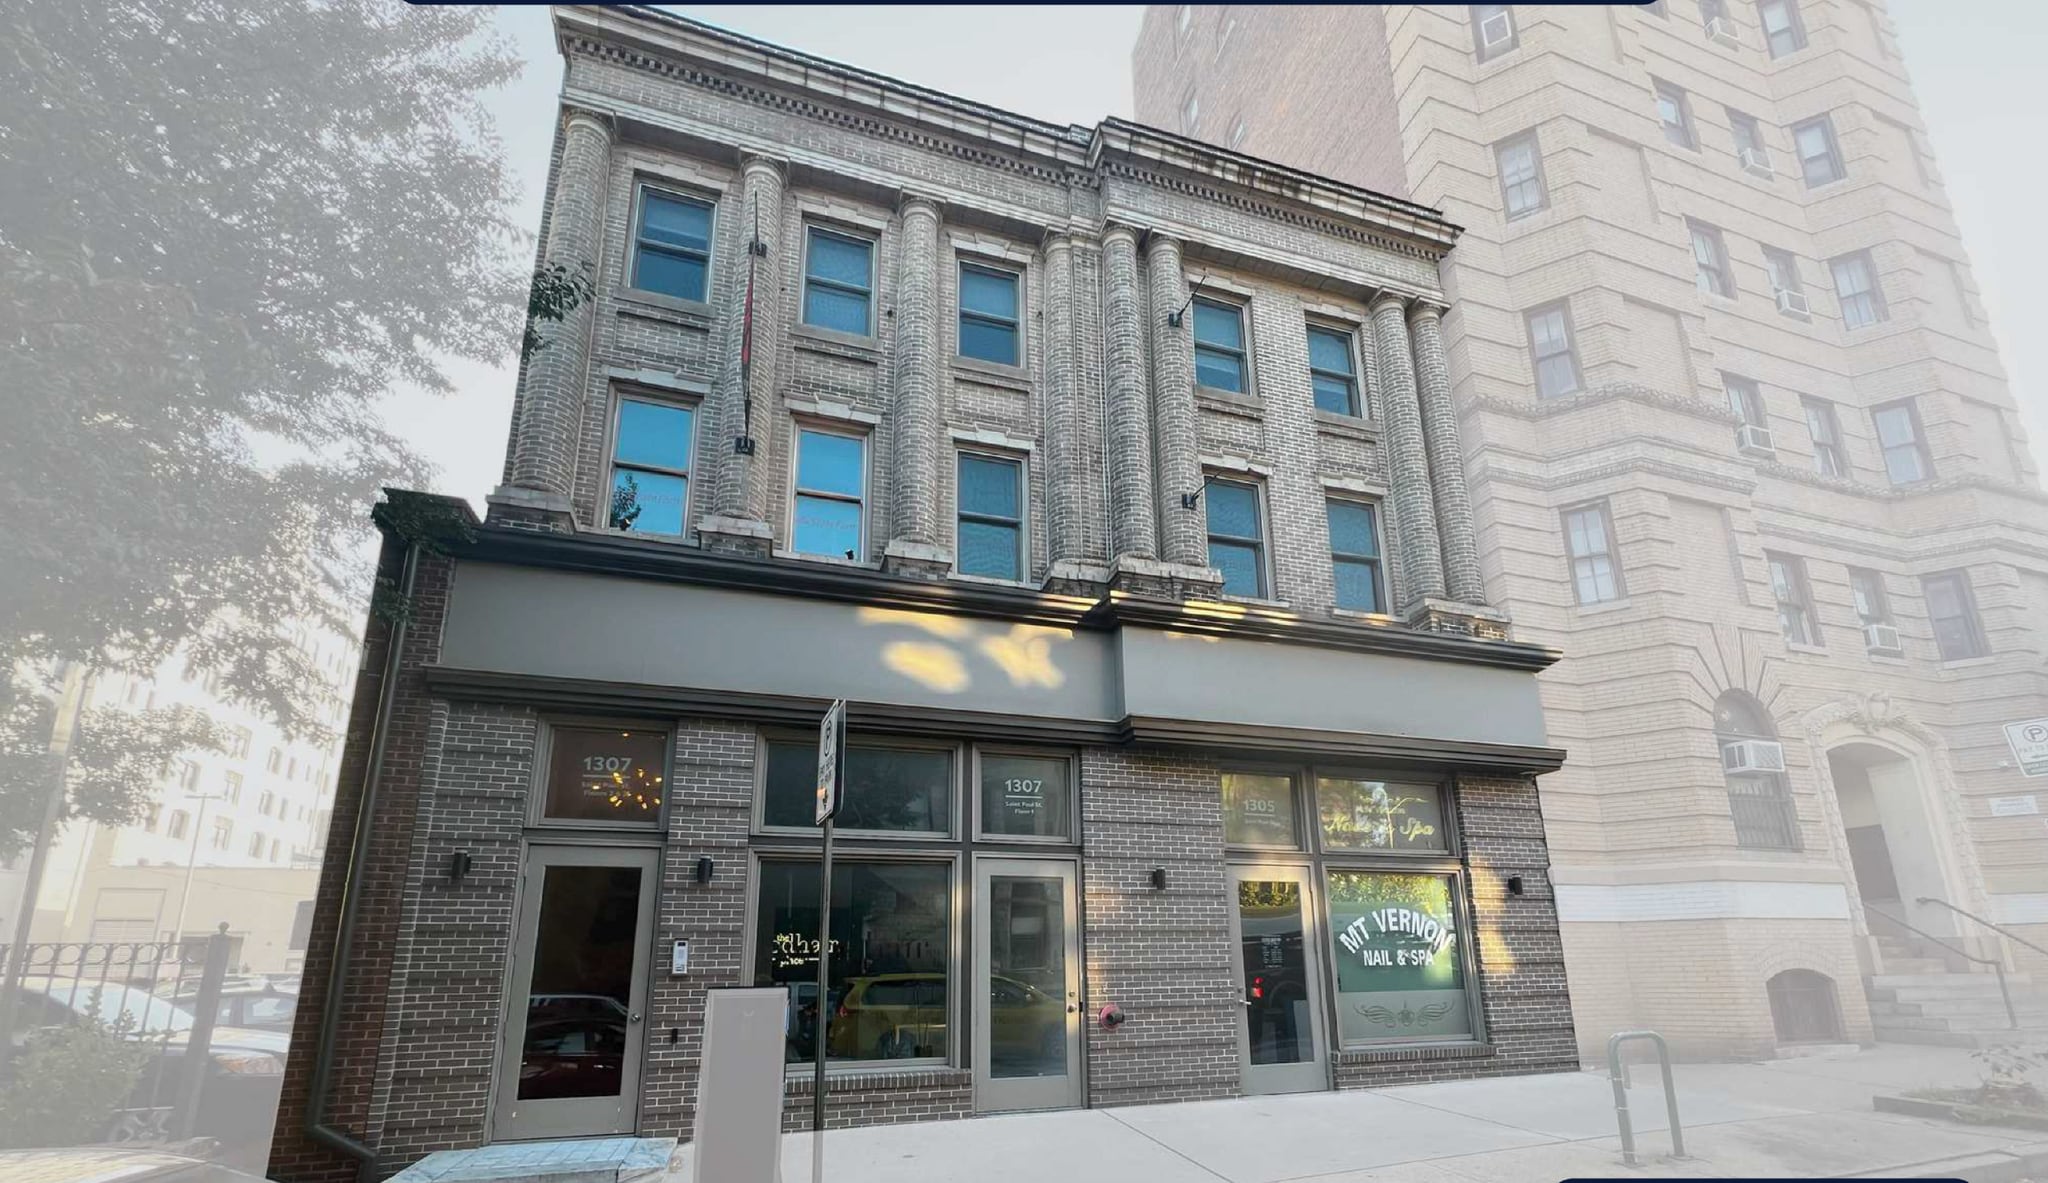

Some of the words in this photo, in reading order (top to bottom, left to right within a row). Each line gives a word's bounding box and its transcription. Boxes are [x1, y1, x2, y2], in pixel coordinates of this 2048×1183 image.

[2028, 728, 2042, 740] P
[583, 756, 633, 771] 1307
[1005, 779, 1042, 792] 1307
[1243, 799, 1275, 812] 1305
[1400, 817, 1435, 841] Spa
[1339, 917, 1370, 954] MT
[1371, 908, 1454, 953] VERNON
[1363, 949, 1393, 966] NAIL
[1397, 949, 1409, 966] &
[1411, 949, 1435, 966] SPA
